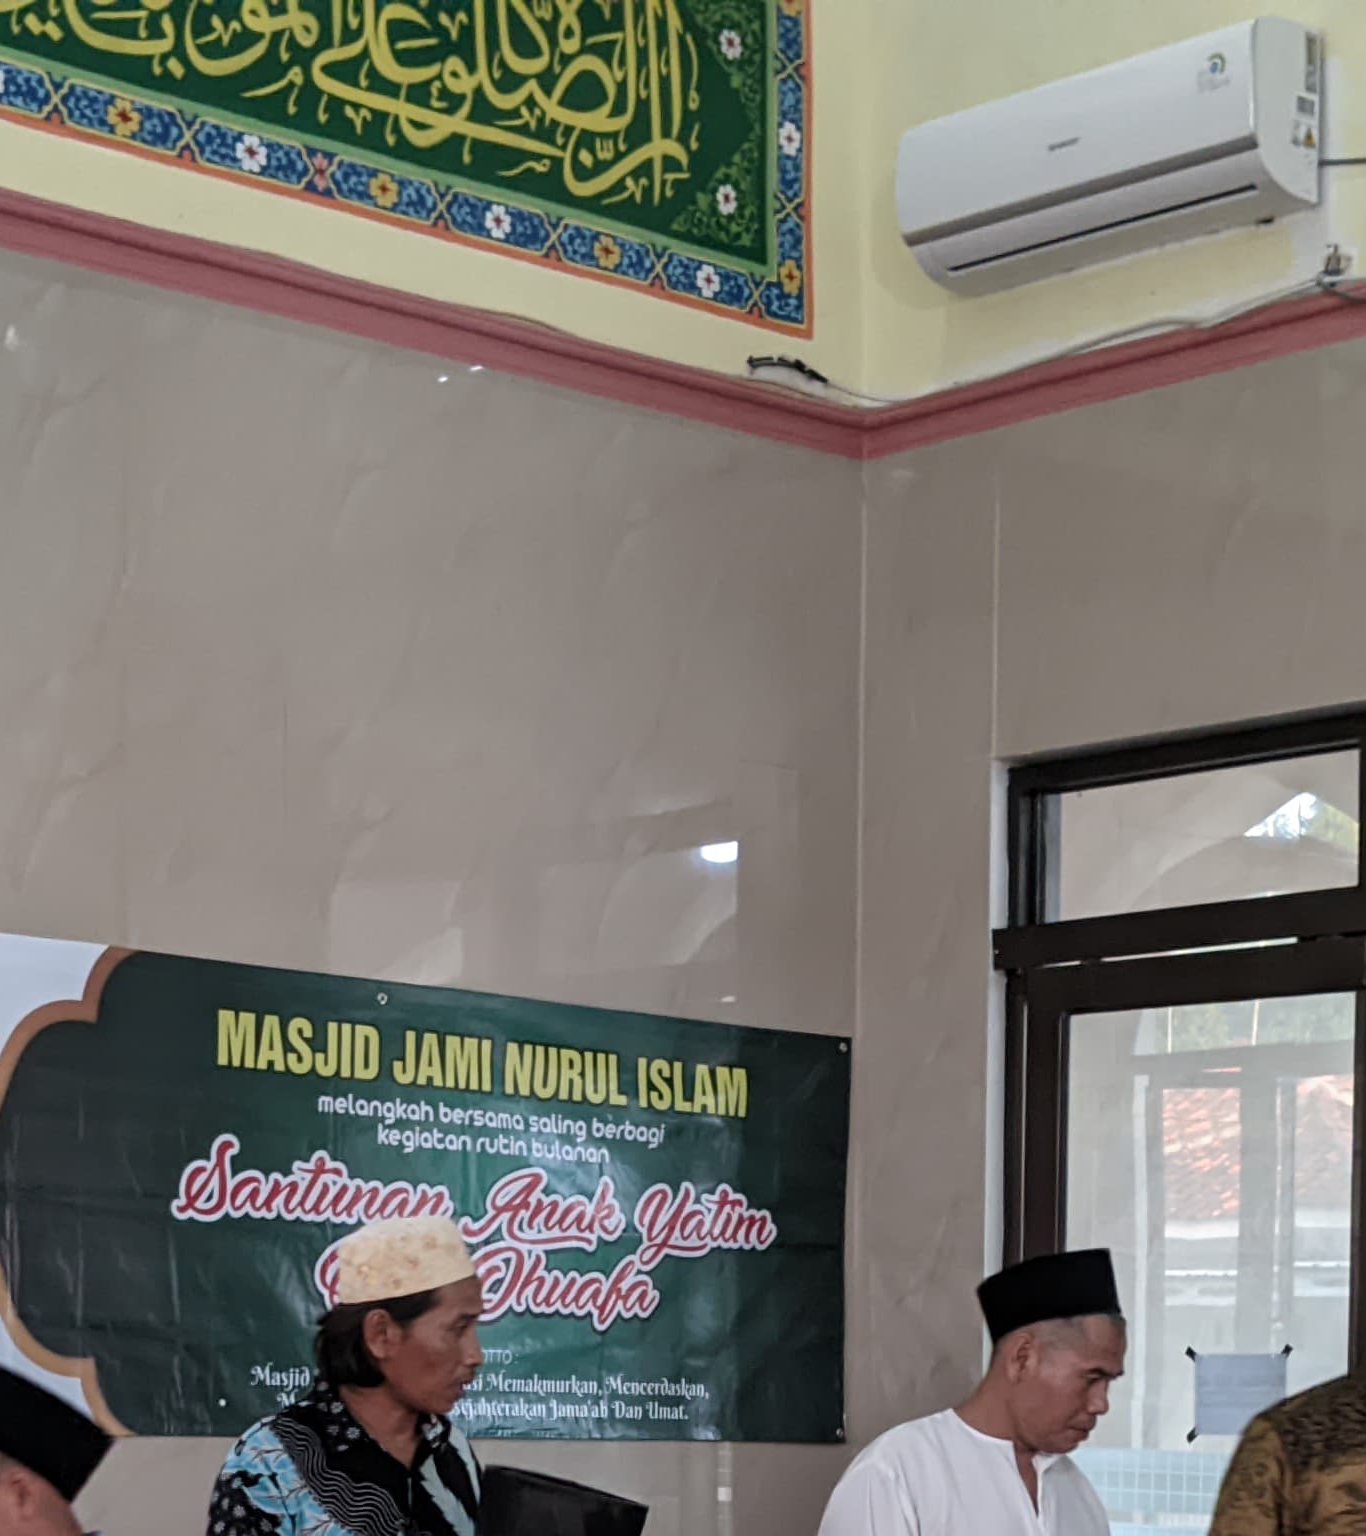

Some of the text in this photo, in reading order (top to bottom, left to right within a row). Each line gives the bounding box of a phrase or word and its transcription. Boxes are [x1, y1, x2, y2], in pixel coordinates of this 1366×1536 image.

[216, 1008, 748, 1119] MASJID JAMI NURUL ISLAM
[317, 1094, 666, 1149] melangkah bersama saling berbagi
[377, 1123, 610, 1163] kegiatan rutin bulanan
[171, 1134, 778, 1271] Santunan Anak Yatim
[250, 1362, 311, 1393] Masjid
[485, 1369, 603, 1397] Memakmurkan,
[605, 1374, 710, 1400] Mencerdaskan,
[610, 1401, 643, 1421] Dan
